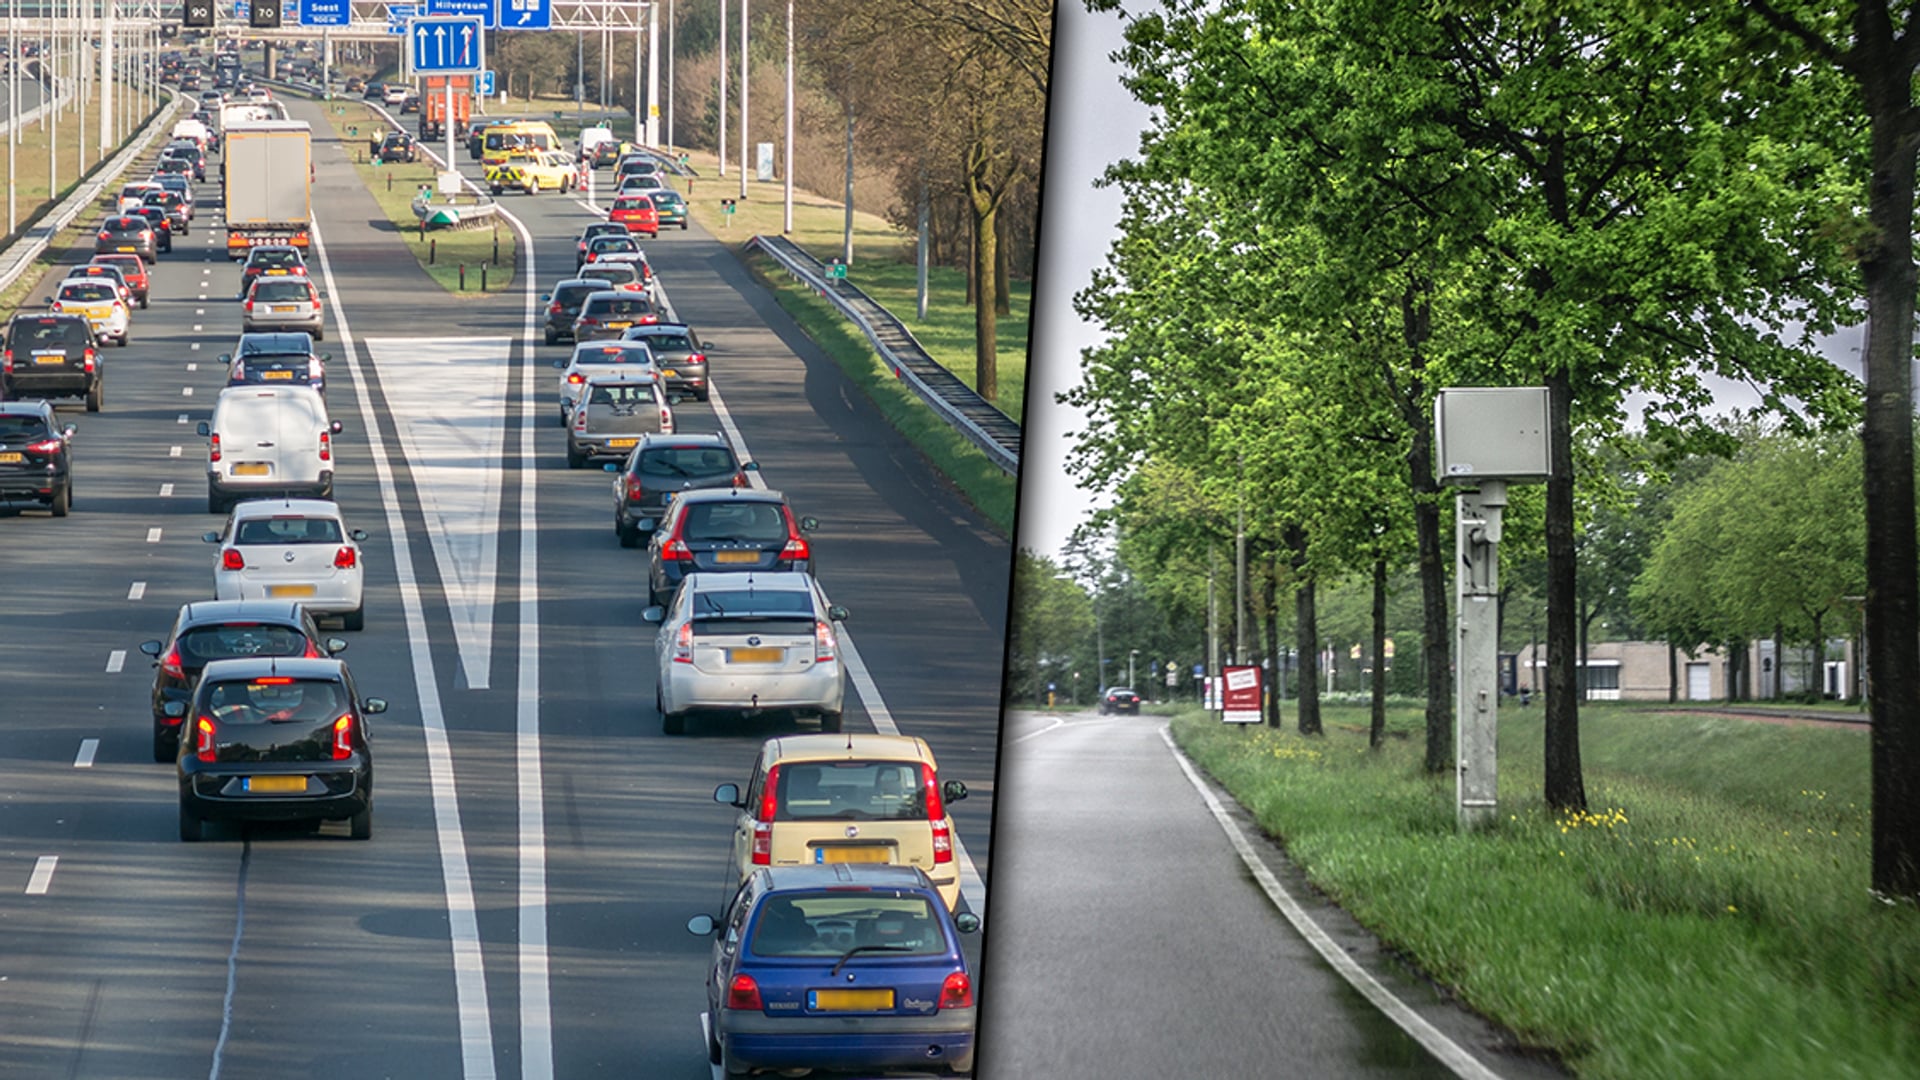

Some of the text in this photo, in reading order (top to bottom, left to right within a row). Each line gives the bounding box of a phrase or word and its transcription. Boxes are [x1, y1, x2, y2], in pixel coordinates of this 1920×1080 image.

[311, 3, 339, 12] Soest
[435, 2, 488, 10] Hilversum
[192, 7, 207, 18] 90
[258, 8, 274, 18] 70
